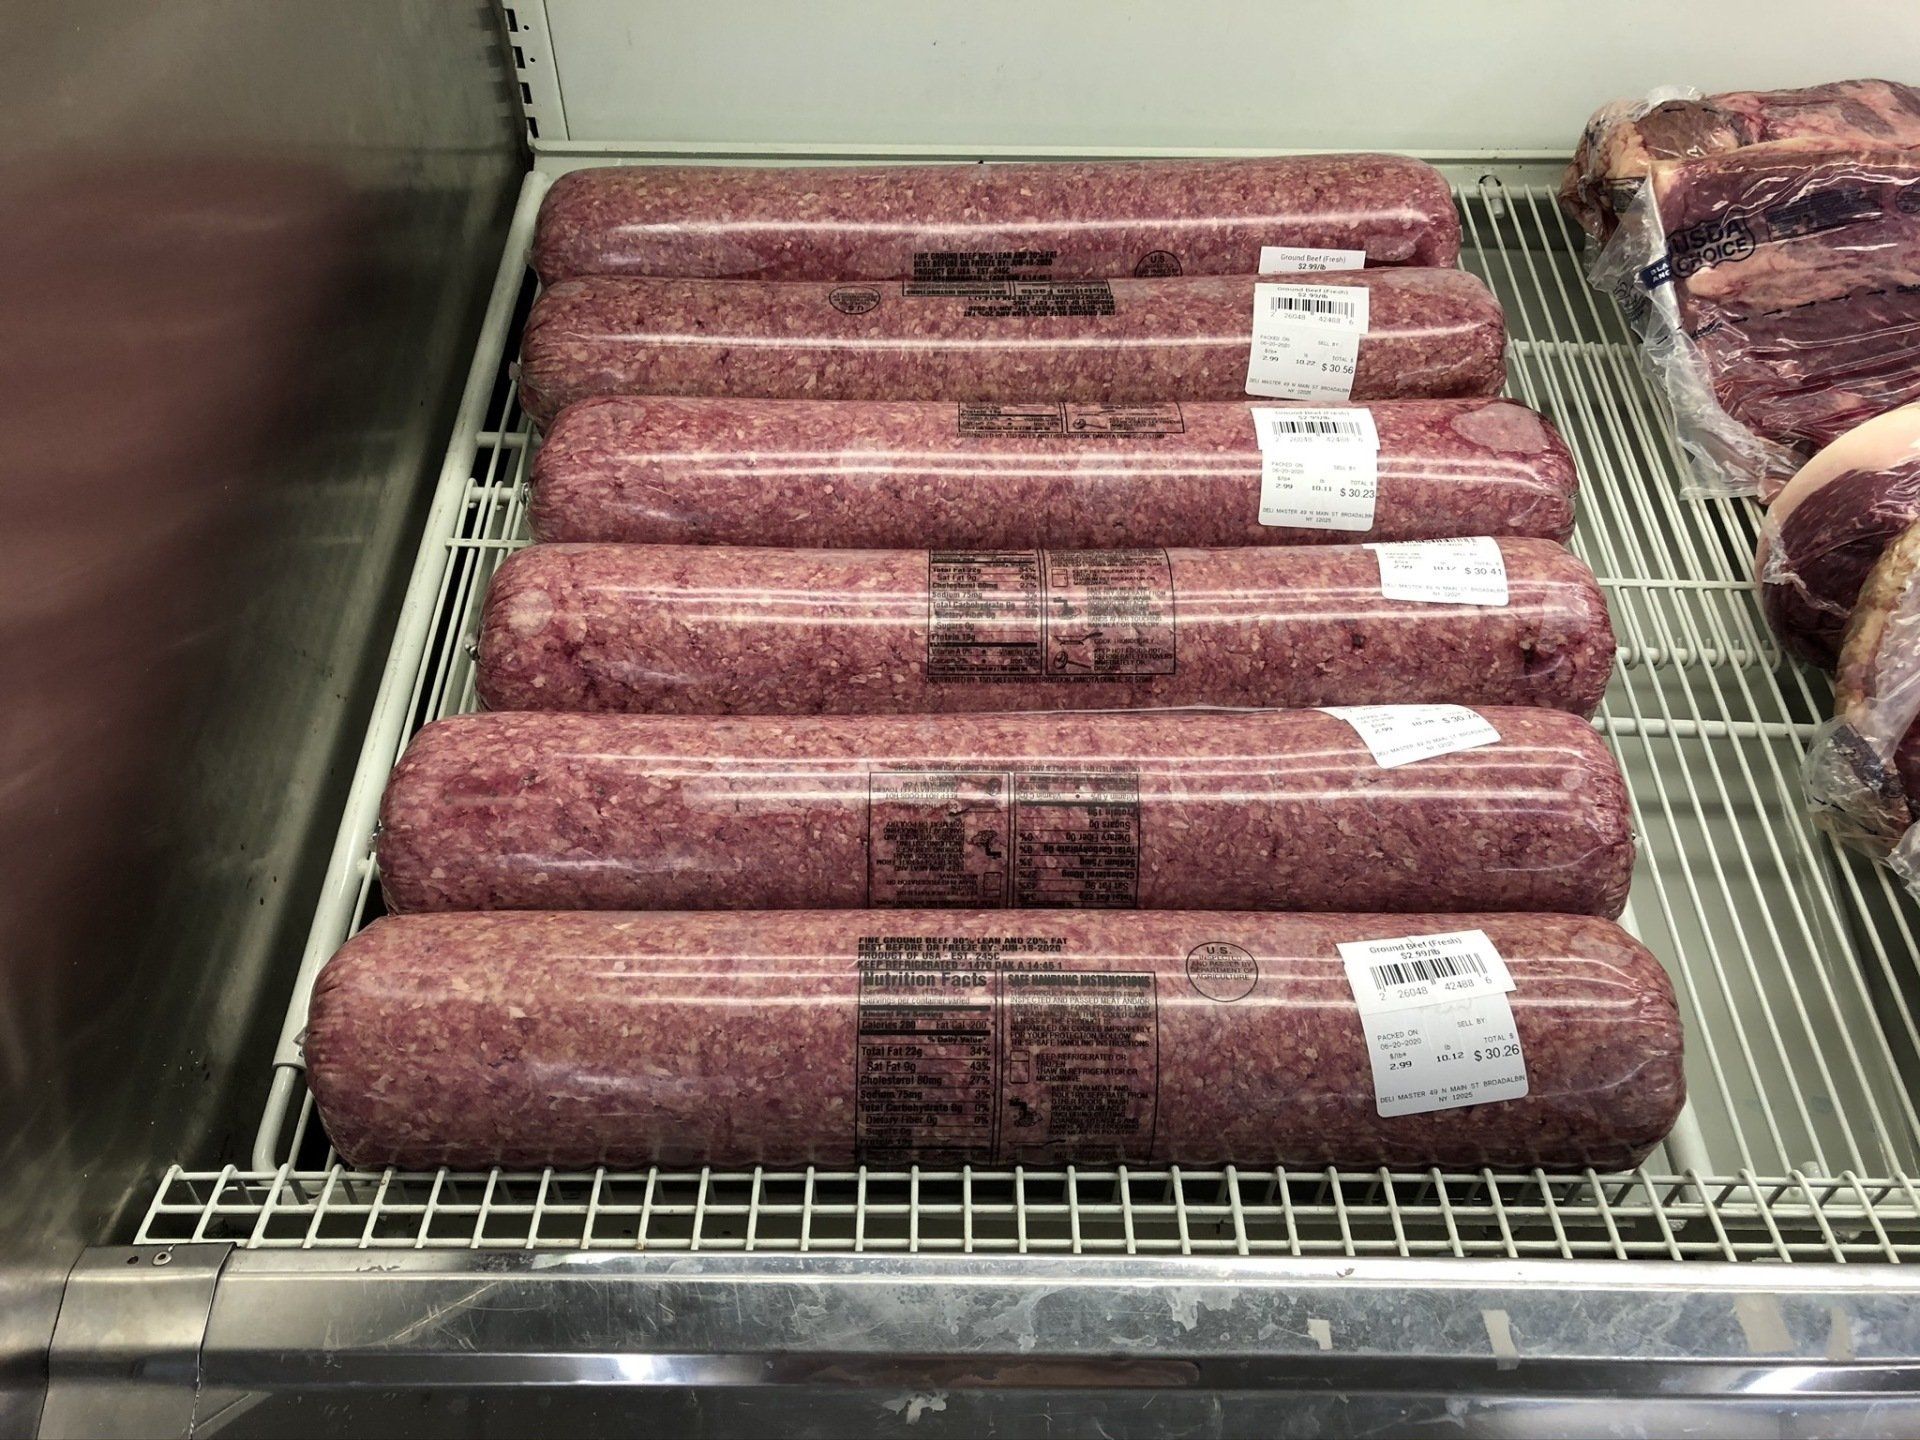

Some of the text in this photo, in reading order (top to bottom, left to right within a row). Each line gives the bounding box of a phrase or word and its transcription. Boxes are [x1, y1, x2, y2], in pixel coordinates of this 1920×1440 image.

[1672, 219, 1744, 254] USDA
[1280, 253, 1346, 264] Ground Beef (Fresh)
[1679, 237, 1749, 270] CHOICE
[952, 937, 975, 945] 80%
[977, 937, 1002, 945] LEAN
[1004, 937, 1024, 945] AND
[1026, 937, 1049, 945] 20%
[1051, 937, 1069, 945] FAT
[1369, 937, 1463, 954] Ground Beef (Fresh)
[857, 951, 1000, 960] PRODUCT OF USA EST. 245C
[1206, 946, 1233, 955] U.S.
[1400, 949, 1440, 961] $2.99/lb
[857, 960, 884, 969] KEEP
[885, 960, 958, 970] REFRIGERATED
[967, 961, 992, 970] 1470
[1017, 962, 1025, 970] A
[862, 971, 988, 987] Nutrition Facts
[1007, 974, 1151, 988] SAFE HANDLING INSTRUCTIONS
[1379, 992, 1386, 1001] 2
[1397, 986, 1429, 999] 26048
[1484, 976, 1492, 985] 6
[861, 1020, 898, 1029] Calories
[936, 1020, 949, 1029] Fat
[970, 1020, 987, 1029] 200
[1457, 1018, 1474, 1029] SELL
[1377, 1029, 1419, 1042] PACKED ON
[1484, 1034, 1506, 1044] TOTAL
[1379, 1038, 1423, 1051] 06-20-2020
[861, 1046, 991, 1058] Total Fat 22g 34%
[1390, 1044, 1521, 1071] 2.99 10.12 $ 30.26
[867, 1061, 991, 1073] Sat Fat 9g 43%
[861, 1075, 915, 1085] Cholesterol
[917, 1075, 943, 1087] 80mg
[861, 1090, 896, 1099] Sodium
[1380, 1095, 1395, 1104] DELI
[1397, 1090, 1426, 1101] MASTER
[1441, 1087, 1448, 1095] N
[1450, 1084, 1468, 1093] MAIN
[1471, 1081, 1480, 1090] ST
[1483, 1075, 1526, 1089] BROADALBIN
[1438, 1091, 1474, 1103] NY 12025
[861, 1103, 884, 1112] Total
[885, 1103, 949, 1113] Carbohydrate
[866, 1115, 899, 1126] Dietary
[901, 1116, 924, 1125] Fiber
